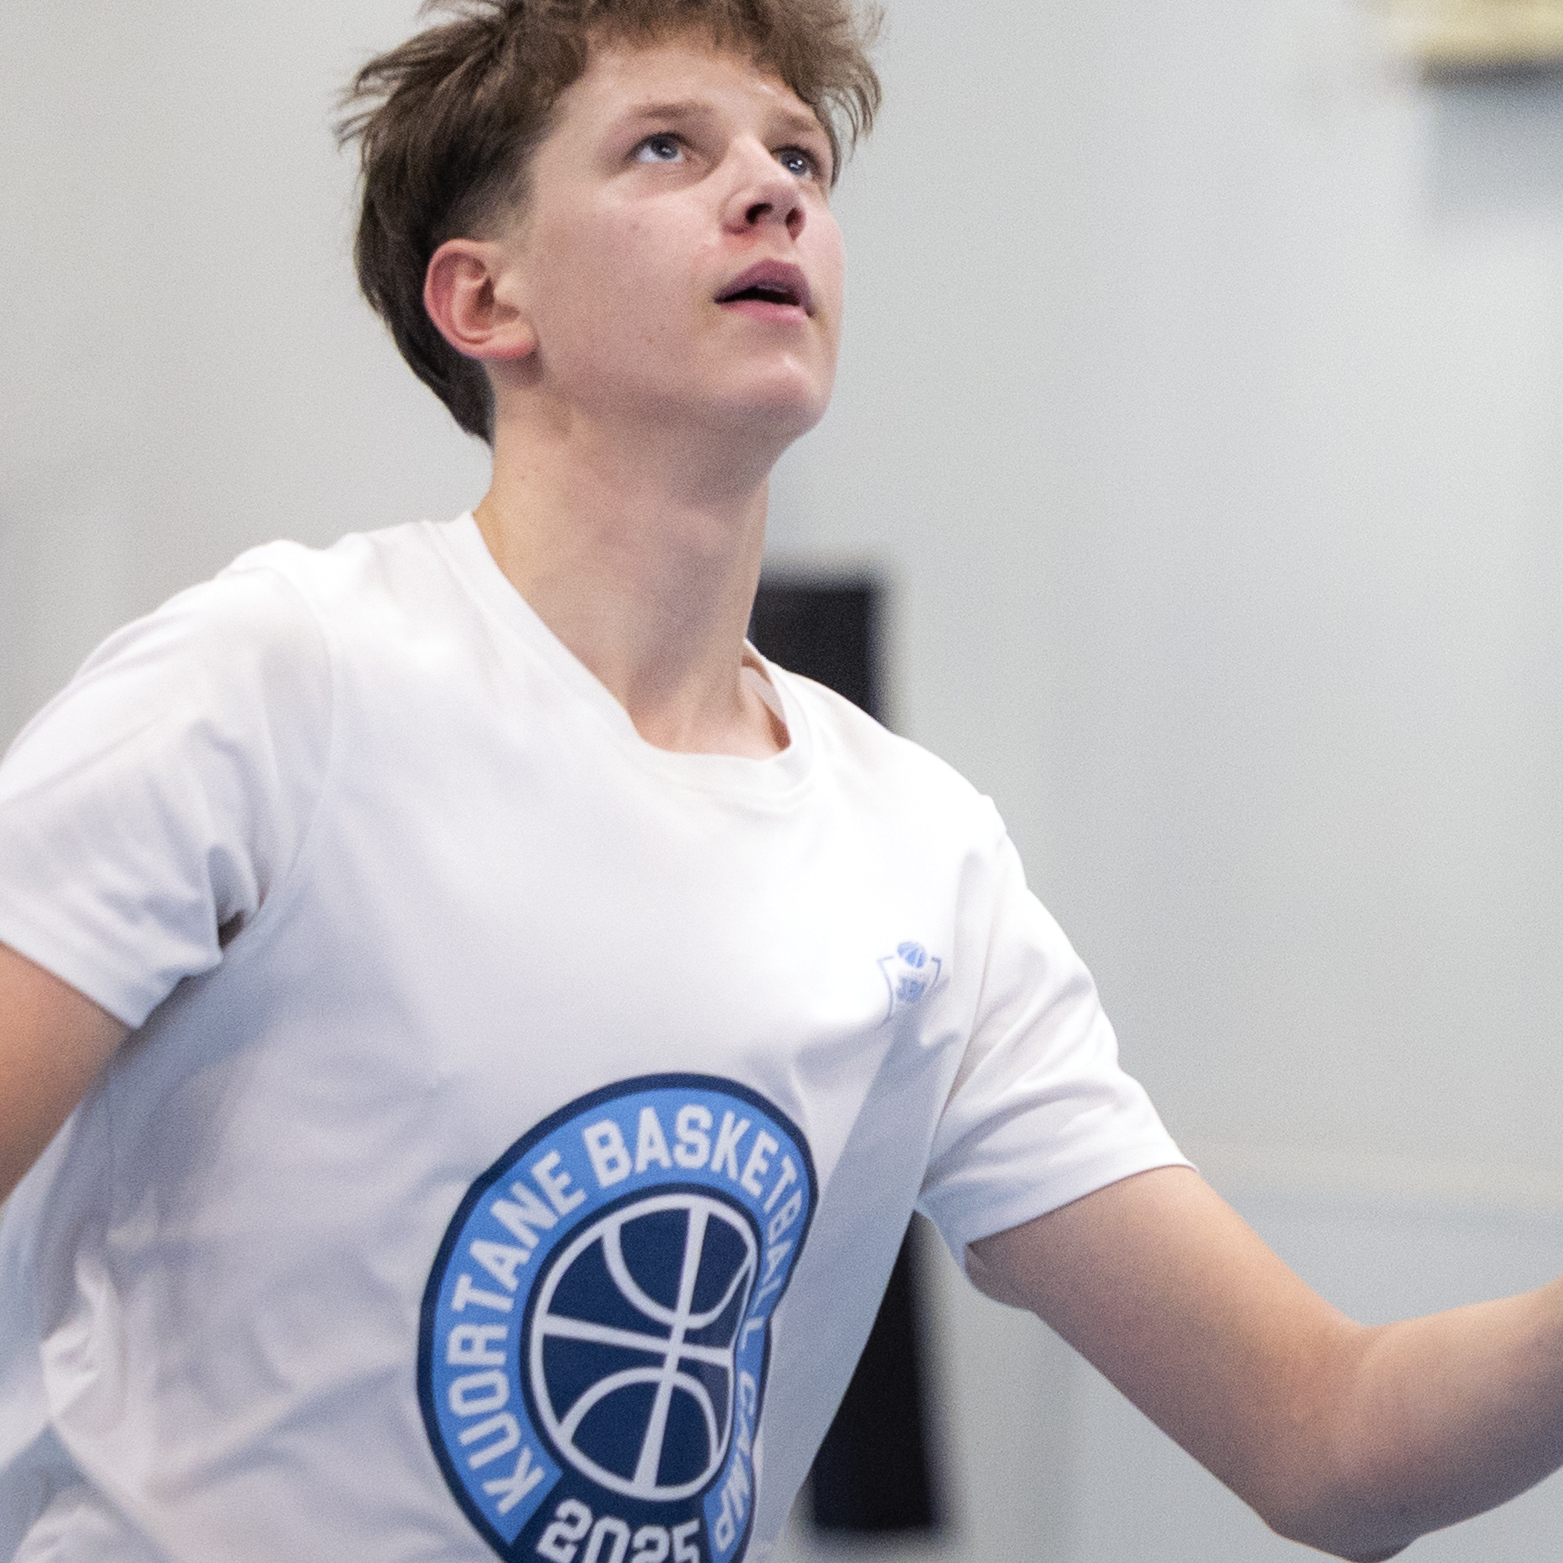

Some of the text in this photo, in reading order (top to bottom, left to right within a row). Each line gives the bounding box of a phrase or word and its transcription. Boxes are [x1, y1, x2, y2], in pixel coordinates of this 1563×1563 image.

[446, 1149, 587, 1516] KUORTANE
[583, 1104, 803, 1351] BASKETBALL
[536, 1497, 701, 1563] 2025
